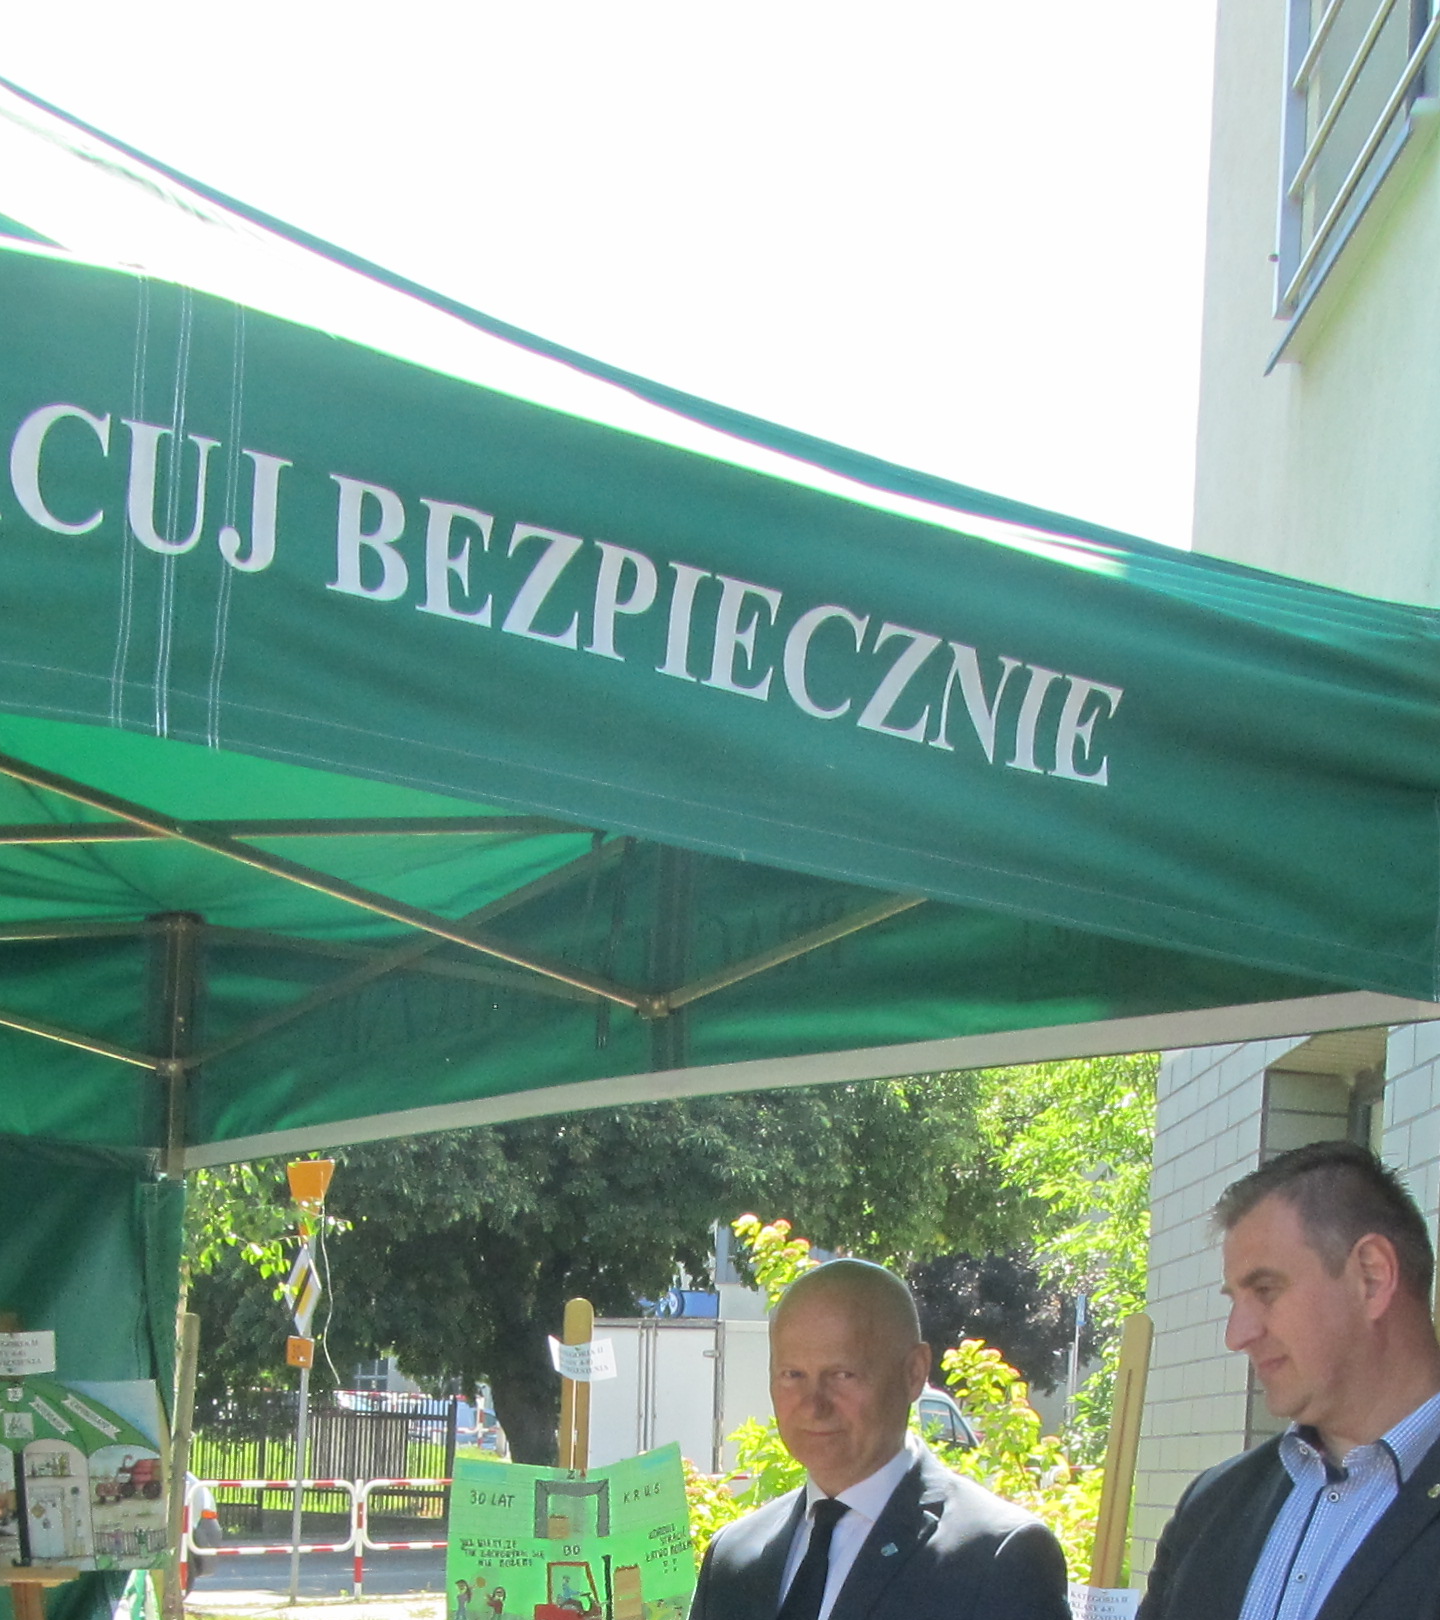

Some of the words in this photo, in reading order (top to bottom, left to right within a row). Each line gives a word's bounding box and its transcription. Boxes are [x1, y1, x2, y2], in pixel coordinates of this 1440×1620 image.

[326, 474, 1122, 786] BEZPIECZNIE
[469, 1489, 486, 1505] 30
[490, 1494, 516, 1508] LAT
